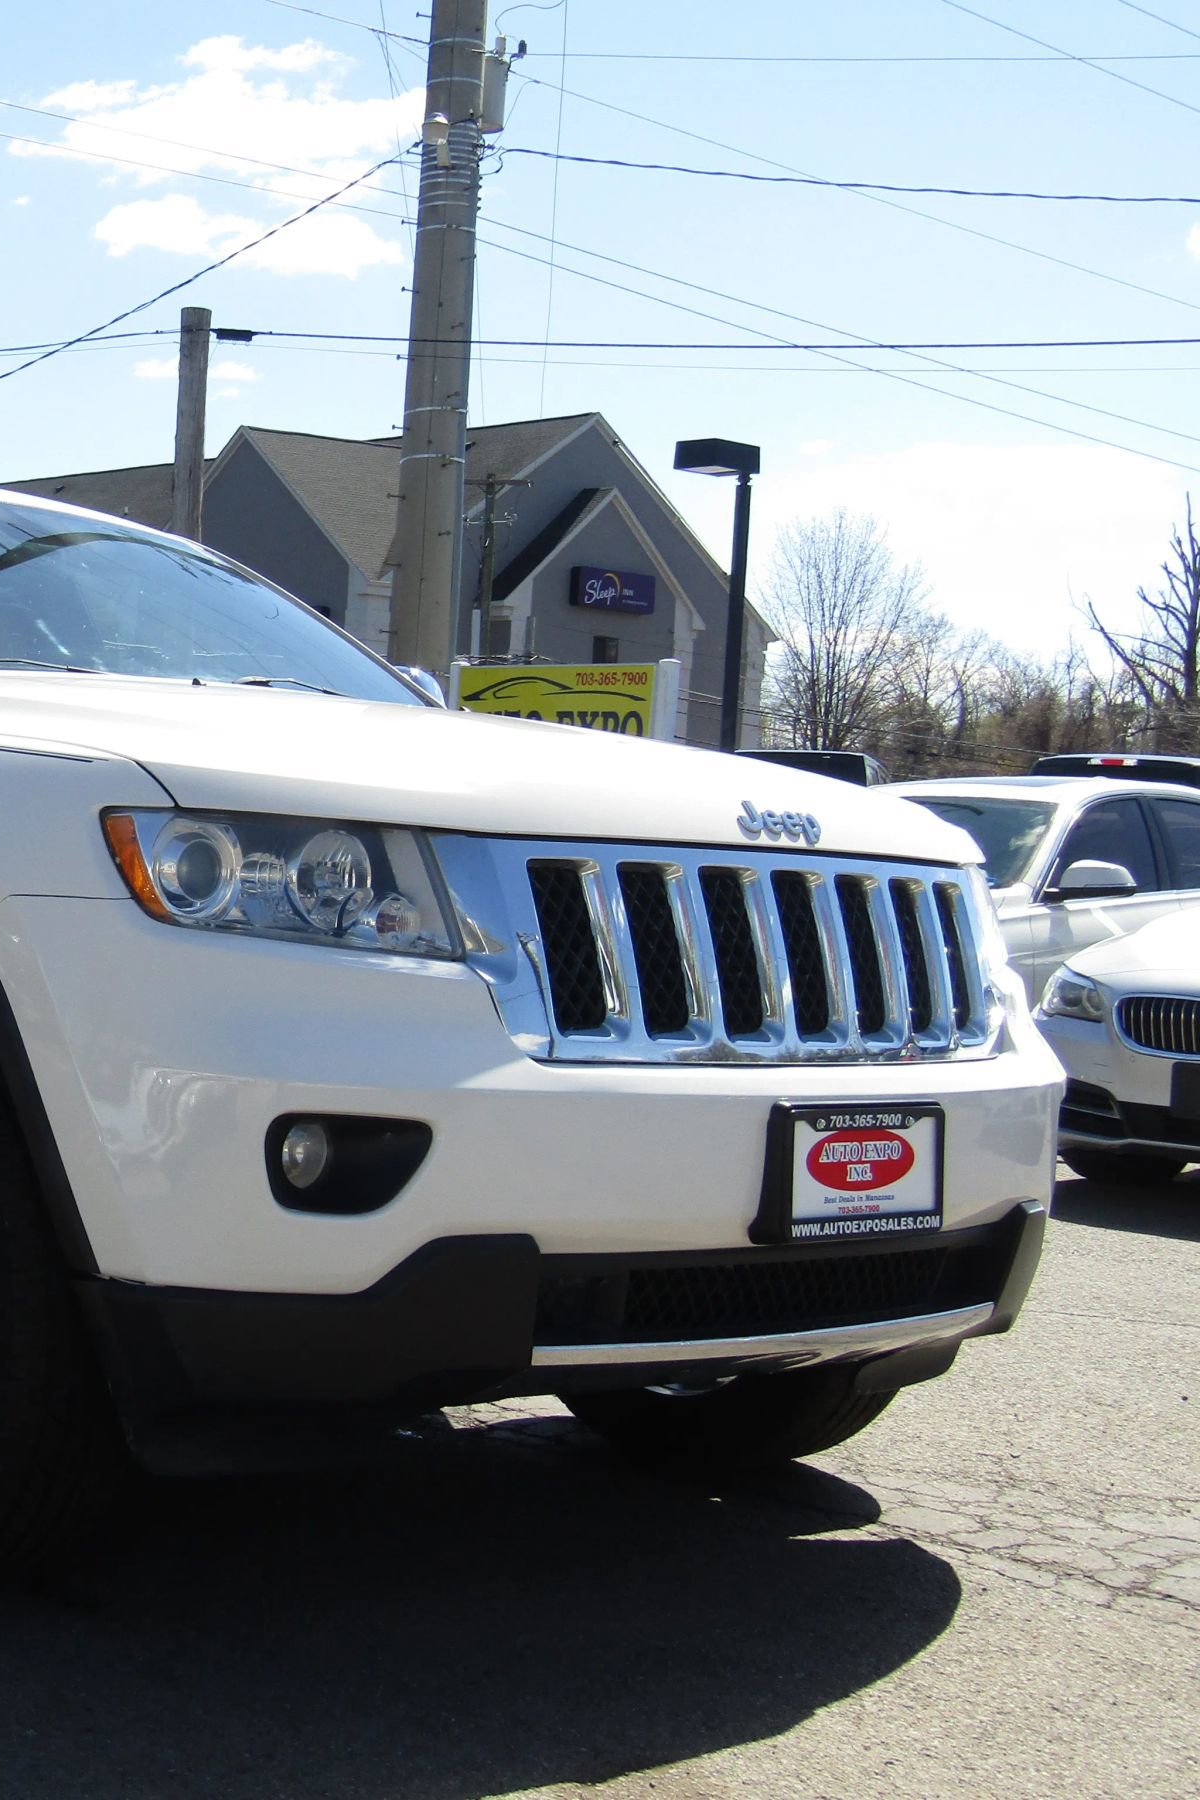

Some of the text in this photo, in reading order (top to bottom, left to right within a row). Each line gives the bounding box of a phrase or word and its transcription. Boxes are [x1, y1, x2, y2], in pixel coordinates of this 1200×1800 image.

[584, 579, 617, 606] Sleep
[575, 671, 648, 686] 703-365-7900
[736, 800, 822, 847] Jeep
[829, 1113, 902, 1128] 703-365-7900
[819, 1140, 902, 1162] AUTO EXPO
[847, 1164, 872, 1181] INC.
[791, 1215, 940, 1237] WWW.AUTOEXPOSALES.COM
